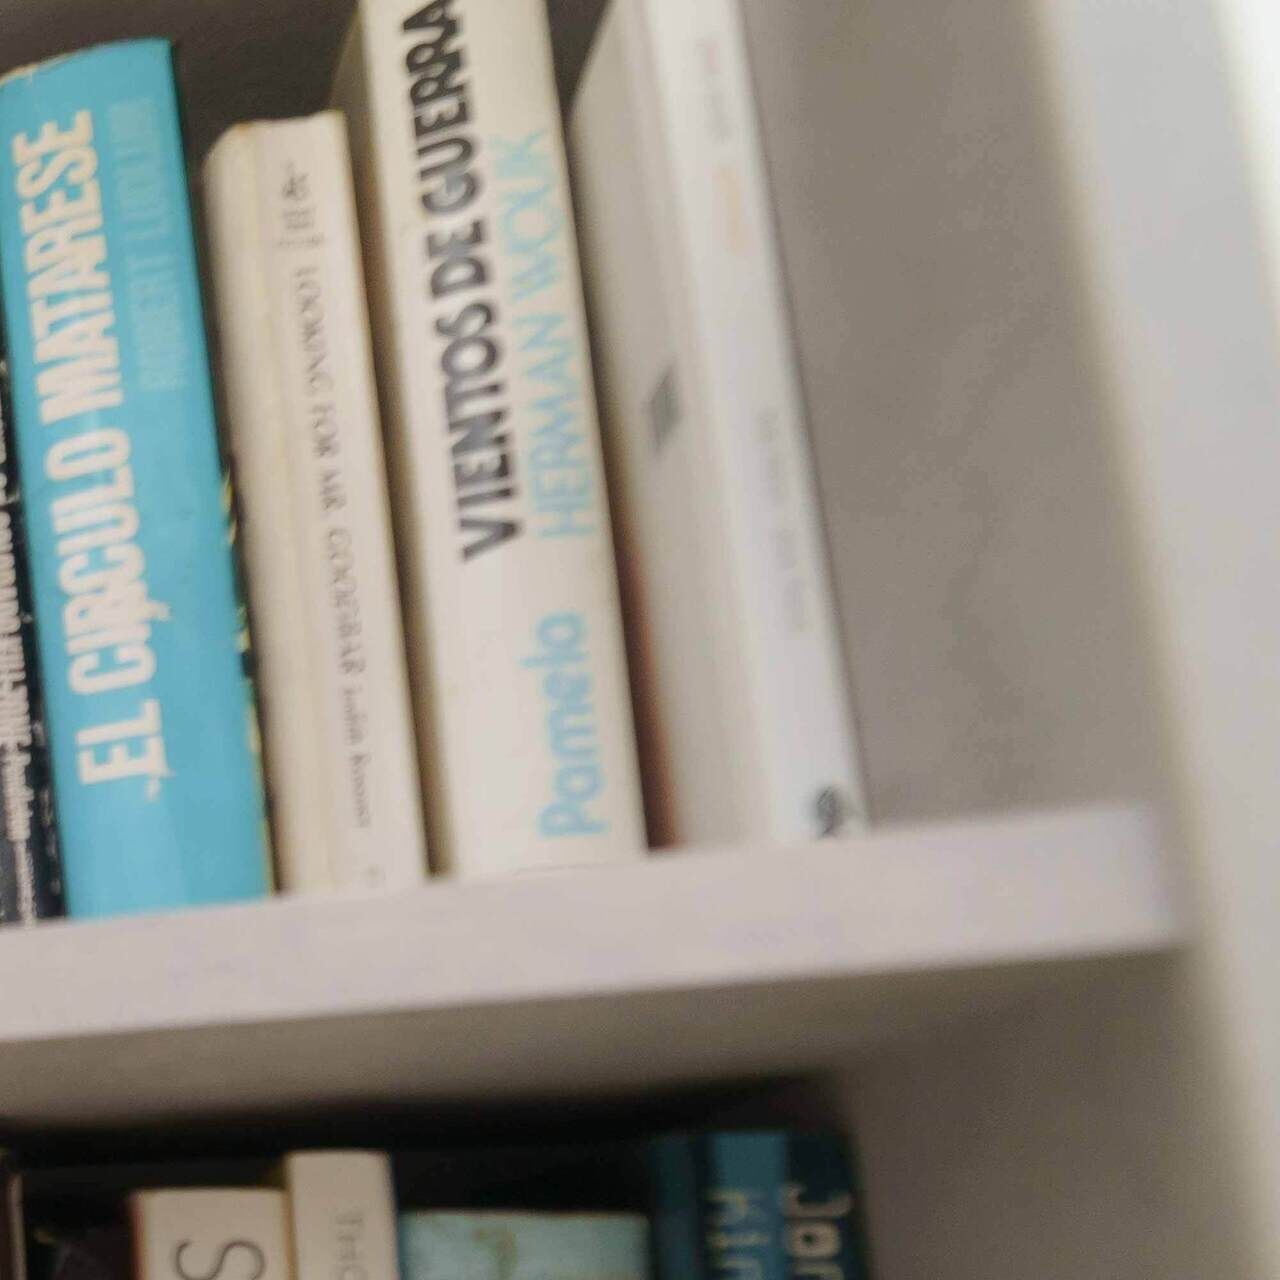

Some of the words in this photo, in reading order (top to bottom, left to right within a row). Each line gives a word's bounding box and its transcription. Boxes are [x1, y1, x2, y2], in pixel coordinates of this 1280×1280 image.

[401, 0, 483, 214] GUERRA
[488, 128, 567, 306] WOUK
[11, 109, 123, 426] MATARESE
[425, 219, 488, 299] DE
[434, 299, 523, 563] VIENTOS
[511, 311, 597, 540] HERMAN
[74, 697, 168, 787] EL
[521, 610, 612, 839] Pamela
